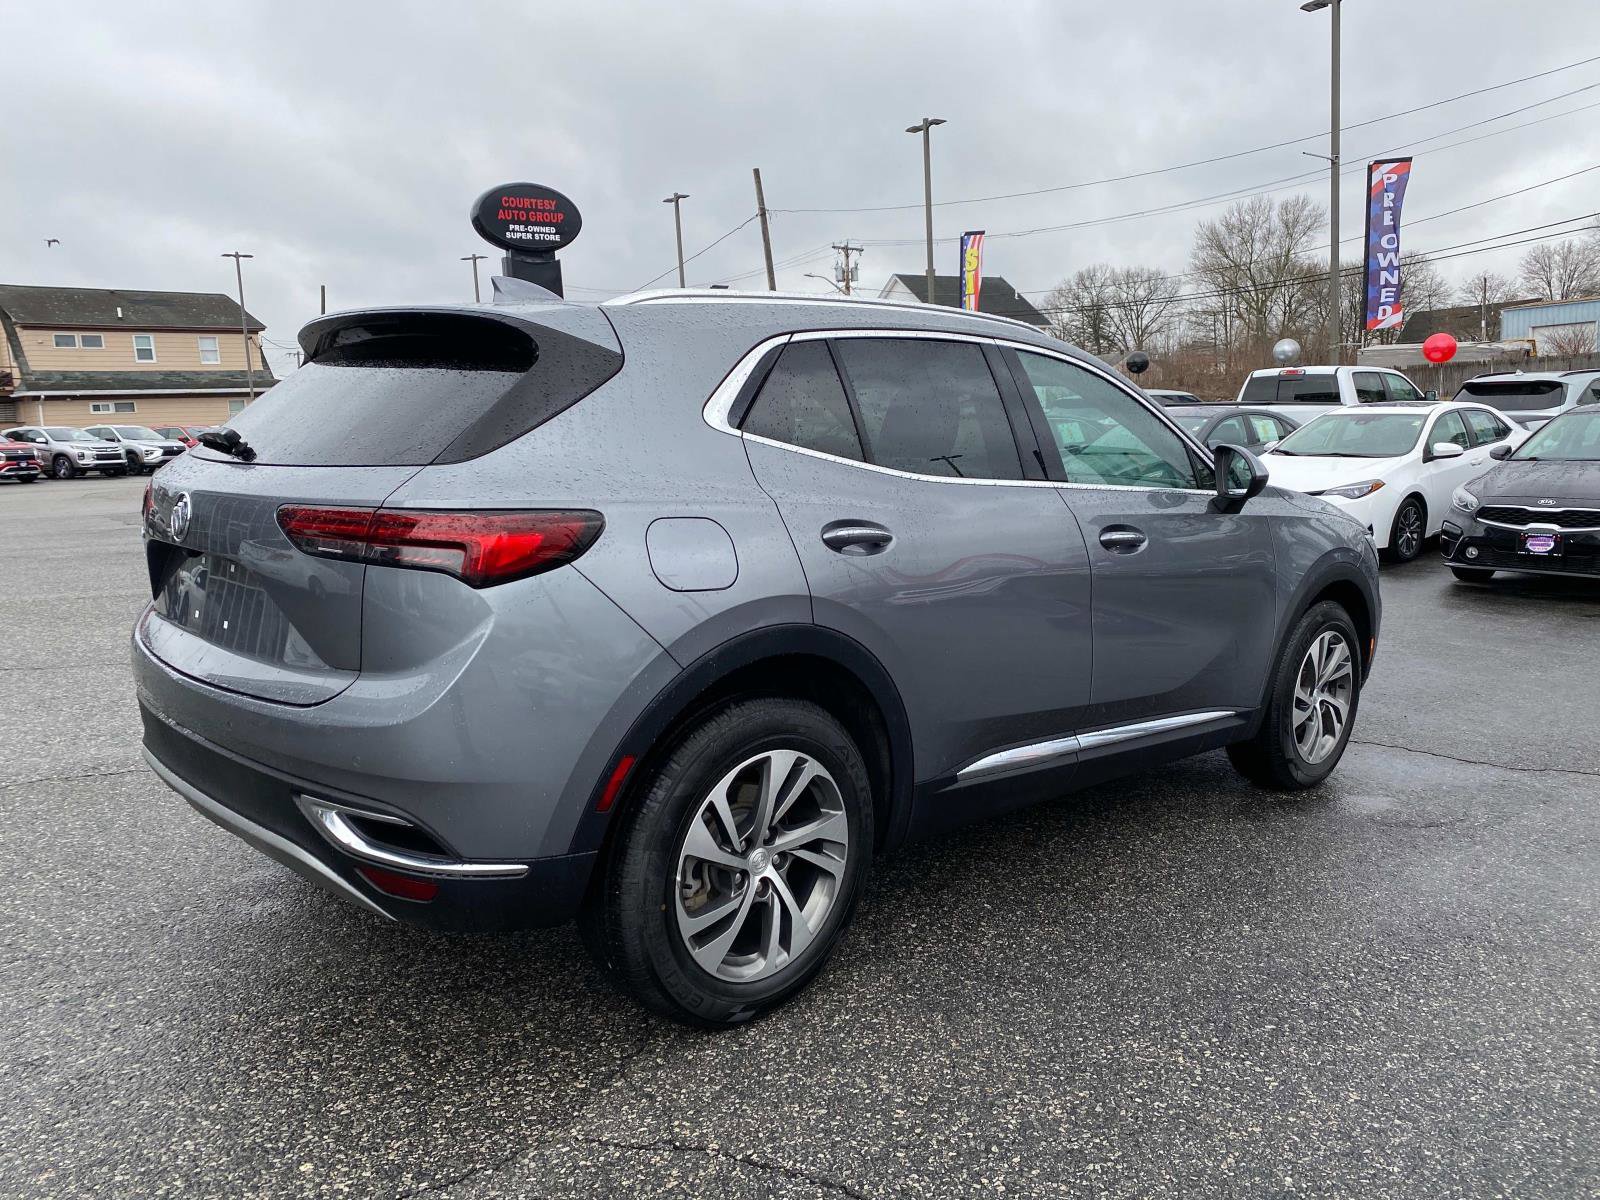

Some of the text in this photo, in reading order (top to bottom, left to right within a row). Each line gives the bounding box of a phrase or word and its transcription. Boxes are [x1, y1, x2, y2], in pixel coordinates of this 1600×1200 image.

[502, 197, 557, 210] COURTESY
[1382, 173, 1398, 226] PRE
[498, 210, 564, 223] AUTO GROUP
[509, 224, 556, 233] PRE-OWNED
[506, 232, 561, 241] SUPER STORE
[1377, 233, 1399, 320] OWNED
